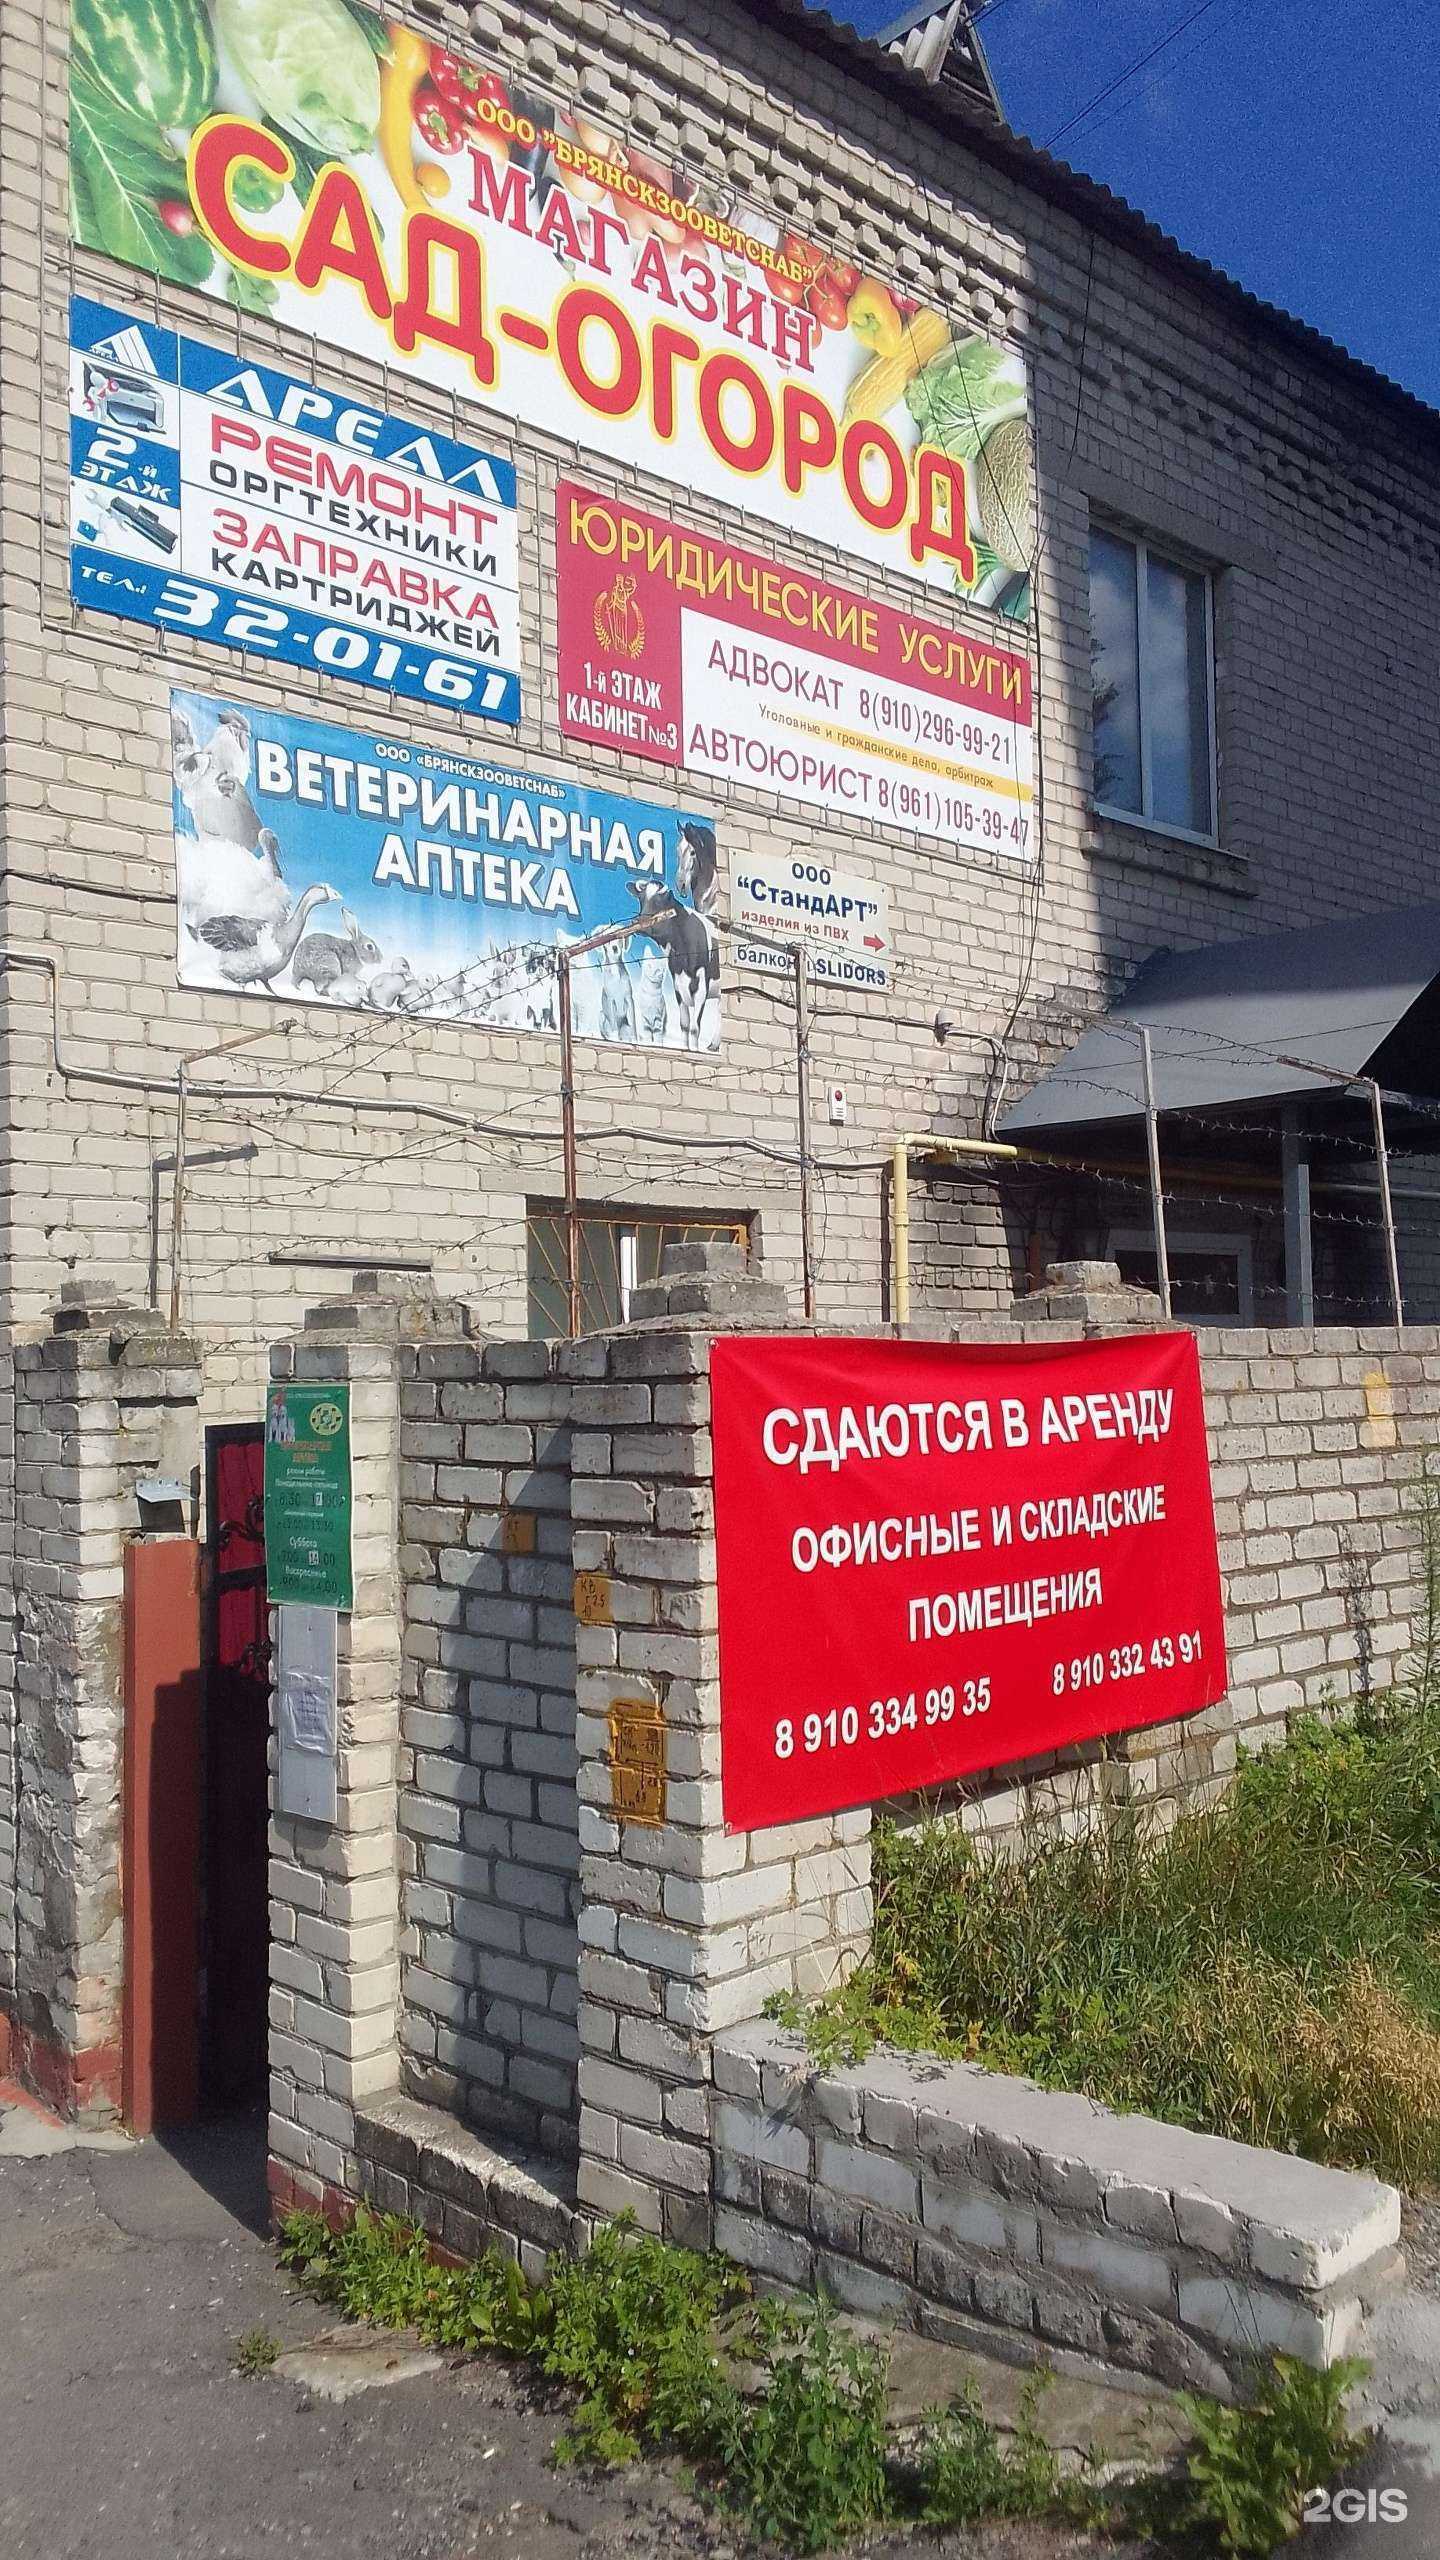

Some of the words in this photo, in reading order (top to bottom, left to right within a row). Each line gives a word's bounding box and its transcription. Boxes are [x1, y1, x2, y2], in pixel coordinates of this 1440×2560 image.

[477, 98, 536, 144] ООО
[467, 146, 815, 373] МАГАЗИН
[190, 118, 976, 586] САД-ОГОРОД
[206, 368, 503, 503] АРЕАЛ
[211, 413, 498, 546] РЕМОНТ
[79, 460, 172, 503] ЭТАЖ
[209, 460, 499, 577] ОРГТЕХНИКИ
[211, 547, 500, 657] КАРТРИДЖЕЙ
[212, 507, 499, 630] ЗАПРАВКА
[570, 498, 880, 654] ЮРИДИЧЕСКИЕ
[898, 622, 1024, 706] УСЛУГИ
[153, 577, 509, 710] 32-01-61
[583, 661, 607, 695] 1-й
[610, 669, 663, 711] ЭТАЖ
[707, 639, 844, 710] АДВОКАТ
[859, 687, 1012, 765] 8(910)296-99-21
[758, 703, 821, 736] Уголовные
[825, 727, 833, 740] и
[836, 732, 909, 763] гражданские
[256, 740, 666, 876] ВЕТЕРИНАРНАЯ
[375, 742, 411, 763] ООО
[416, 753, 567, 800] «БРЯНСКЗООВЕТСНАБ»
[688, 723, 874, 803] АВТОЮРИСТ
[878, 778, 1031, 848] 8(961)105-39-47
[372, 835, 581, 919] АПТЕКА
[737, 875, 878, 923] “СтандАРТ”
[791, 862, 832, 886] ООО
[741, 910, 801, 932] изделия
[804, 921, 820, 936] из
[823, 923, 849, 942] ПВХ
[816, 957, 887, 987] SLIDORS
[762, 1399, 993, 1475] СДАЮТСЯ
[1001, 1397, 1030, 1449] В
[1040, 1387, 1175, 1445] АРЕНДУ
[790, 1510, 982, 1573] ОФИСНЫЕ
[992, 1504, 1013, 1547] И
[1019, 1483, 1167, 1544] СКЛАДСКИЕ
[908, 1567, 1104, 1643] ПОМЕЩЕНИЯ
[1051, 1661, 1065, 1696] 8
[1070, 1650, 1105, 1693] 910
[1109, 1644, 1146, 1682] 332
[1150, 1638, 1176, 1673] 43
[1180, 1630, 1204, 1666] 91
[774, 1718, 794, 1760] 8
[802, 1709, 860, 1755] 910
[867, 1692, 918, 1742] 334
[924, 1684, 956, 1729] 99
[962, 1676, 992, 1717] 35
